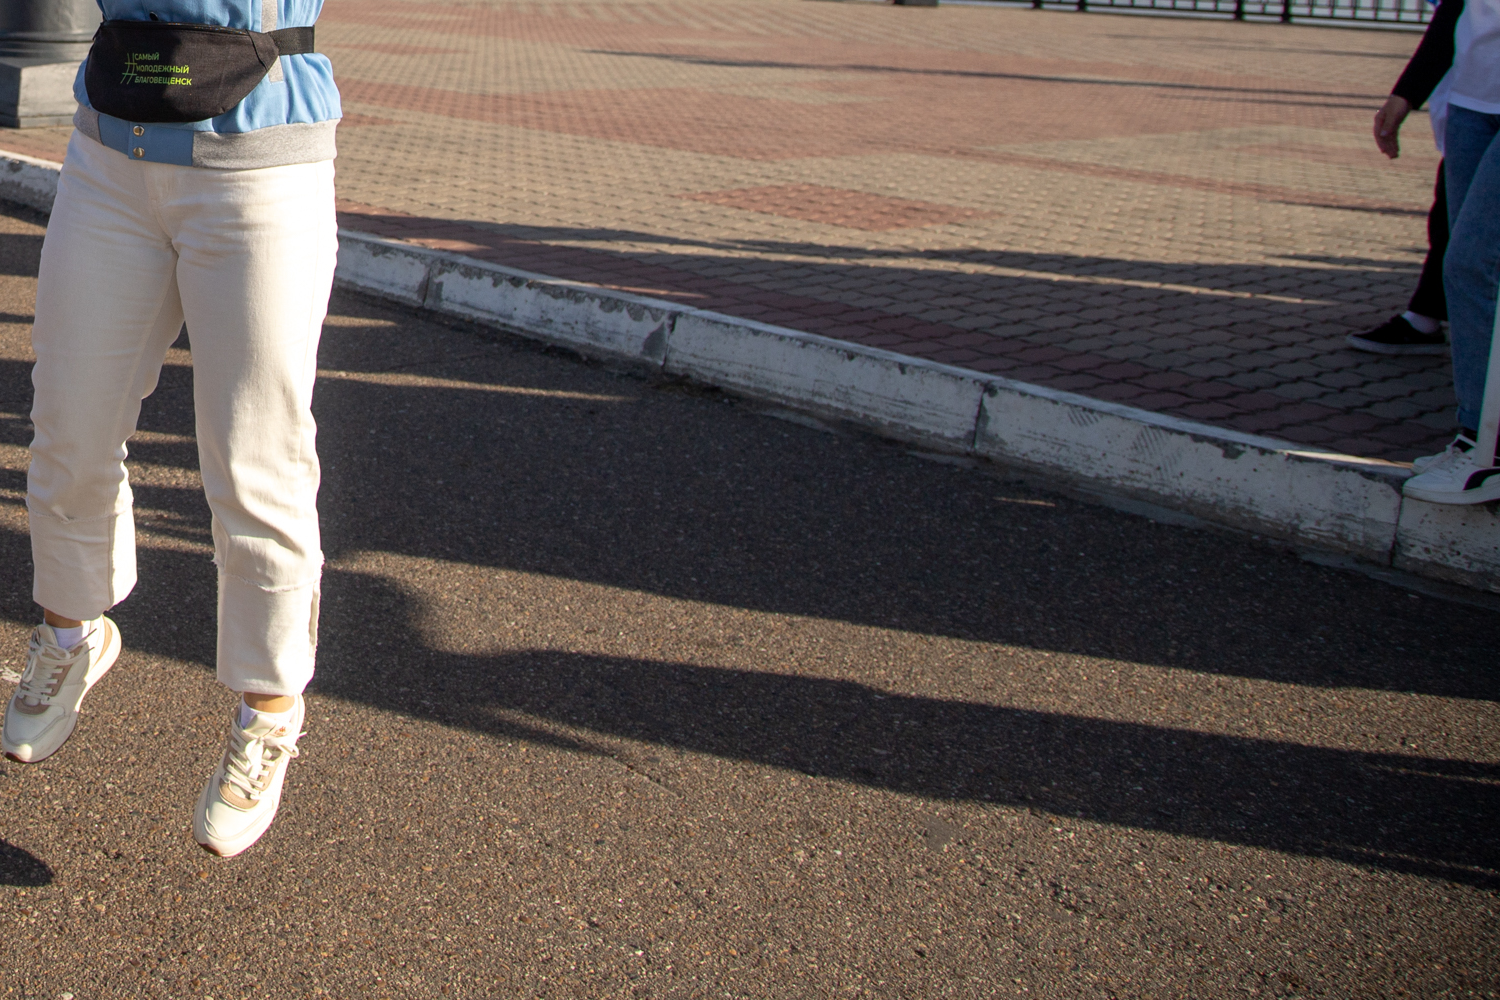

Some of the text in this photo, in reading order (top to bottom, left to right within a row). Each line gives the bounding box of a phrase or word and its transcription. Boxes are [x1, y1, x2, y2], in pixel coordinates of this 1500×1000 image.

[134, 52, 159, 60] САМЫЙ
[136, 65, 190, 74] МОЛОДЕЖНЫЙ
[134, 76, 192, 86] БЛАГОВЕЩЕНСК
